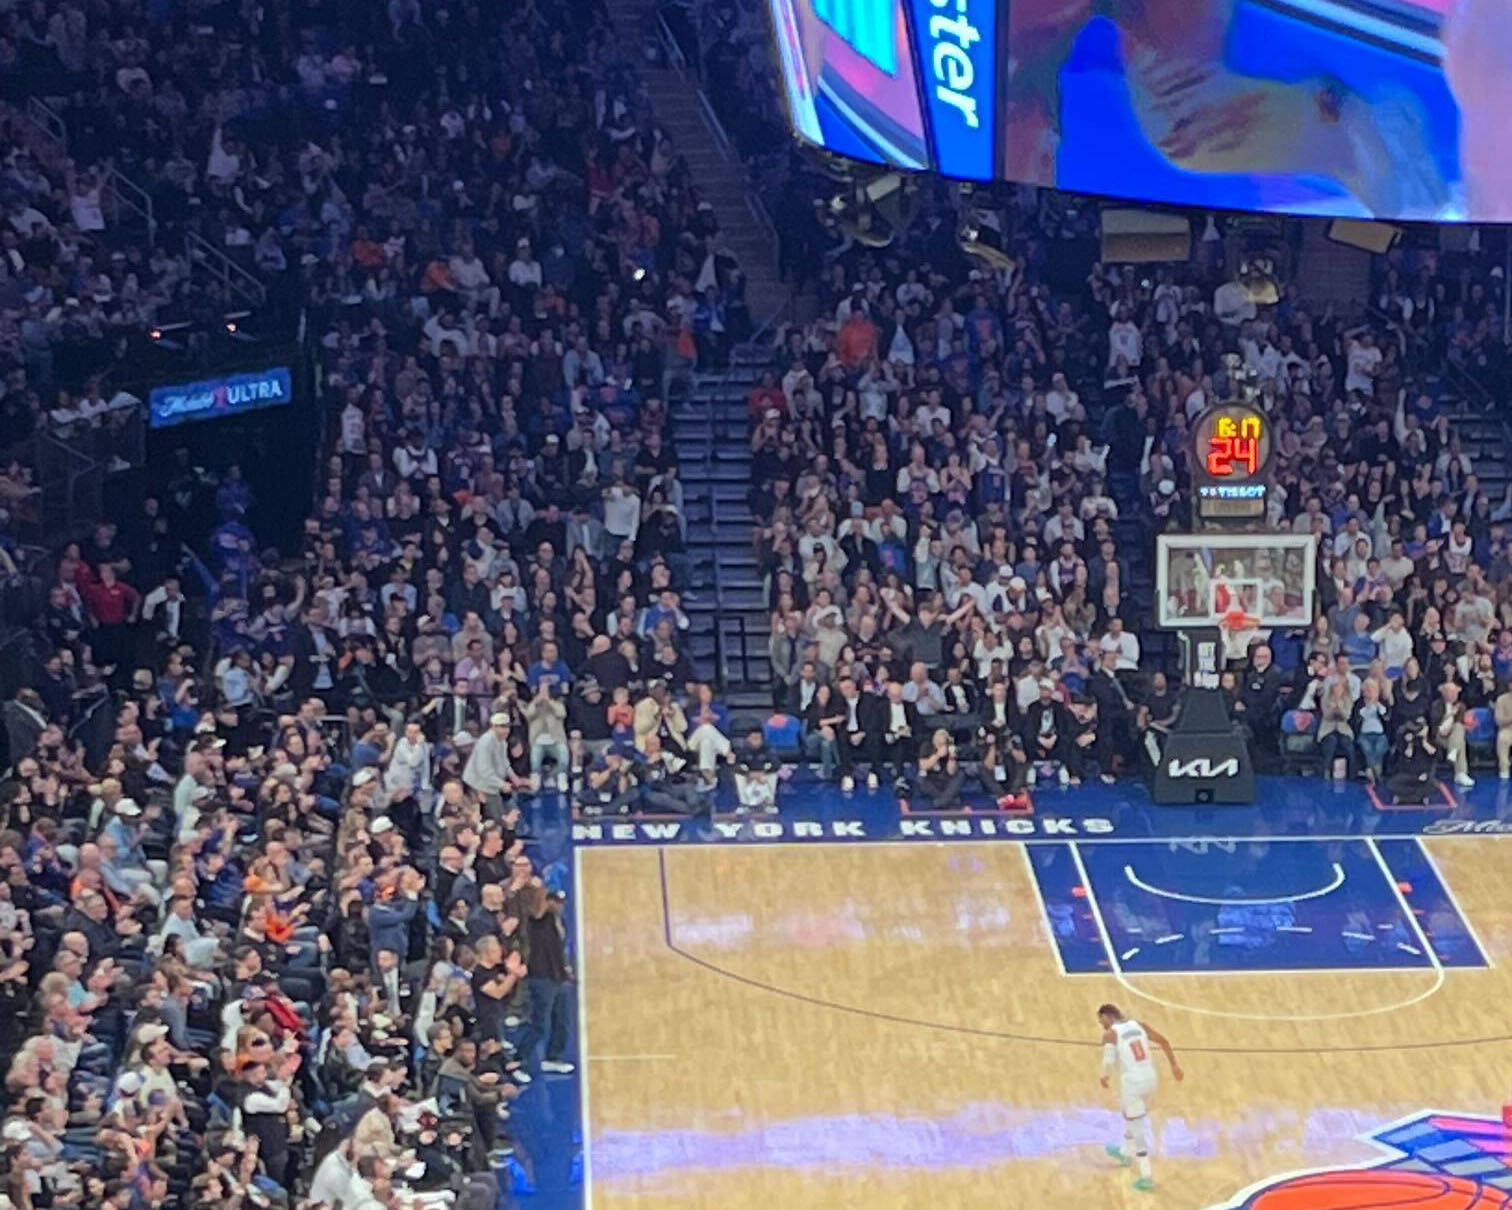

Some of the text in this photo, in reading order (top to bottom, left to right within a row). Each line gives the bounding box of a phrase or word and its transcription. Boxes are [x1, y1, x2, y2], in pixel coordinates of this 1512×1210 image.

[225, 380, 283, 404] ULTRA
[1208, 438, 1257, 475] 24
[1168, 757, 1240, 779] KIA
[572, 817, 1114, 840] NEW YORK KNICKS
